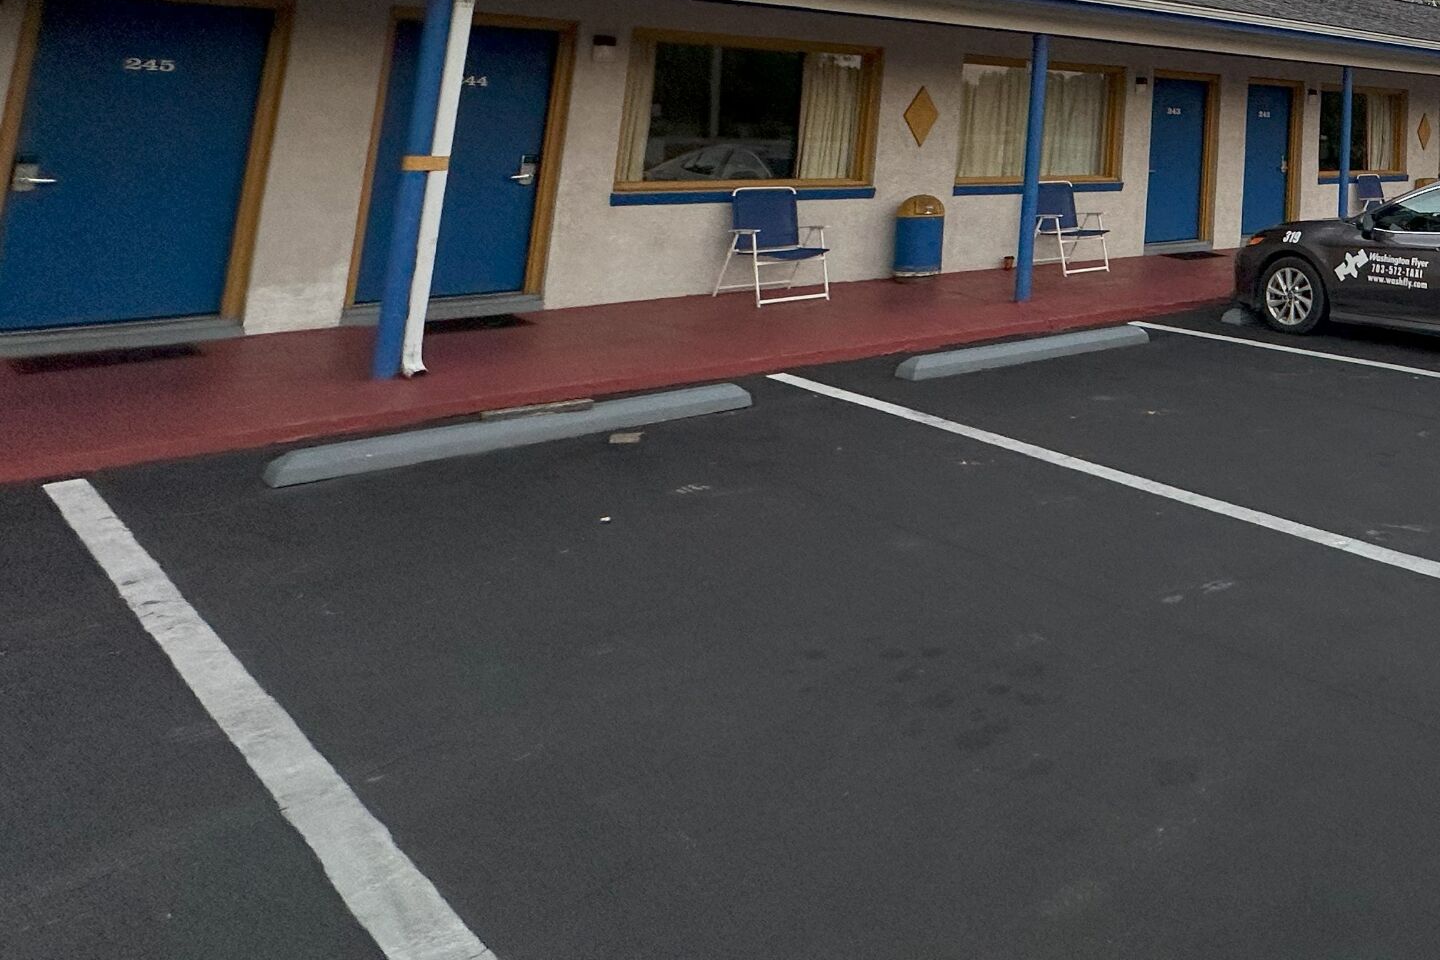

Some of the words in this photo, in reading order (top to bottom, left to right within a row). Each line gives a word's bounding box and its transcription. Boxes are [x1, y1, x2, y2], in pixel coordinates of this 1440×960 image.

[125, 58, 175, 71] 245
[1283, 231, 1301, 243] 319
[1369, 252, 1410, 265] Washington
[1411, 257, 1429, 268] Flyer
[1371, 264, 1423, 278] 703-572-TAXI
[1367, 275, 1428, 289] www.washfly.com
